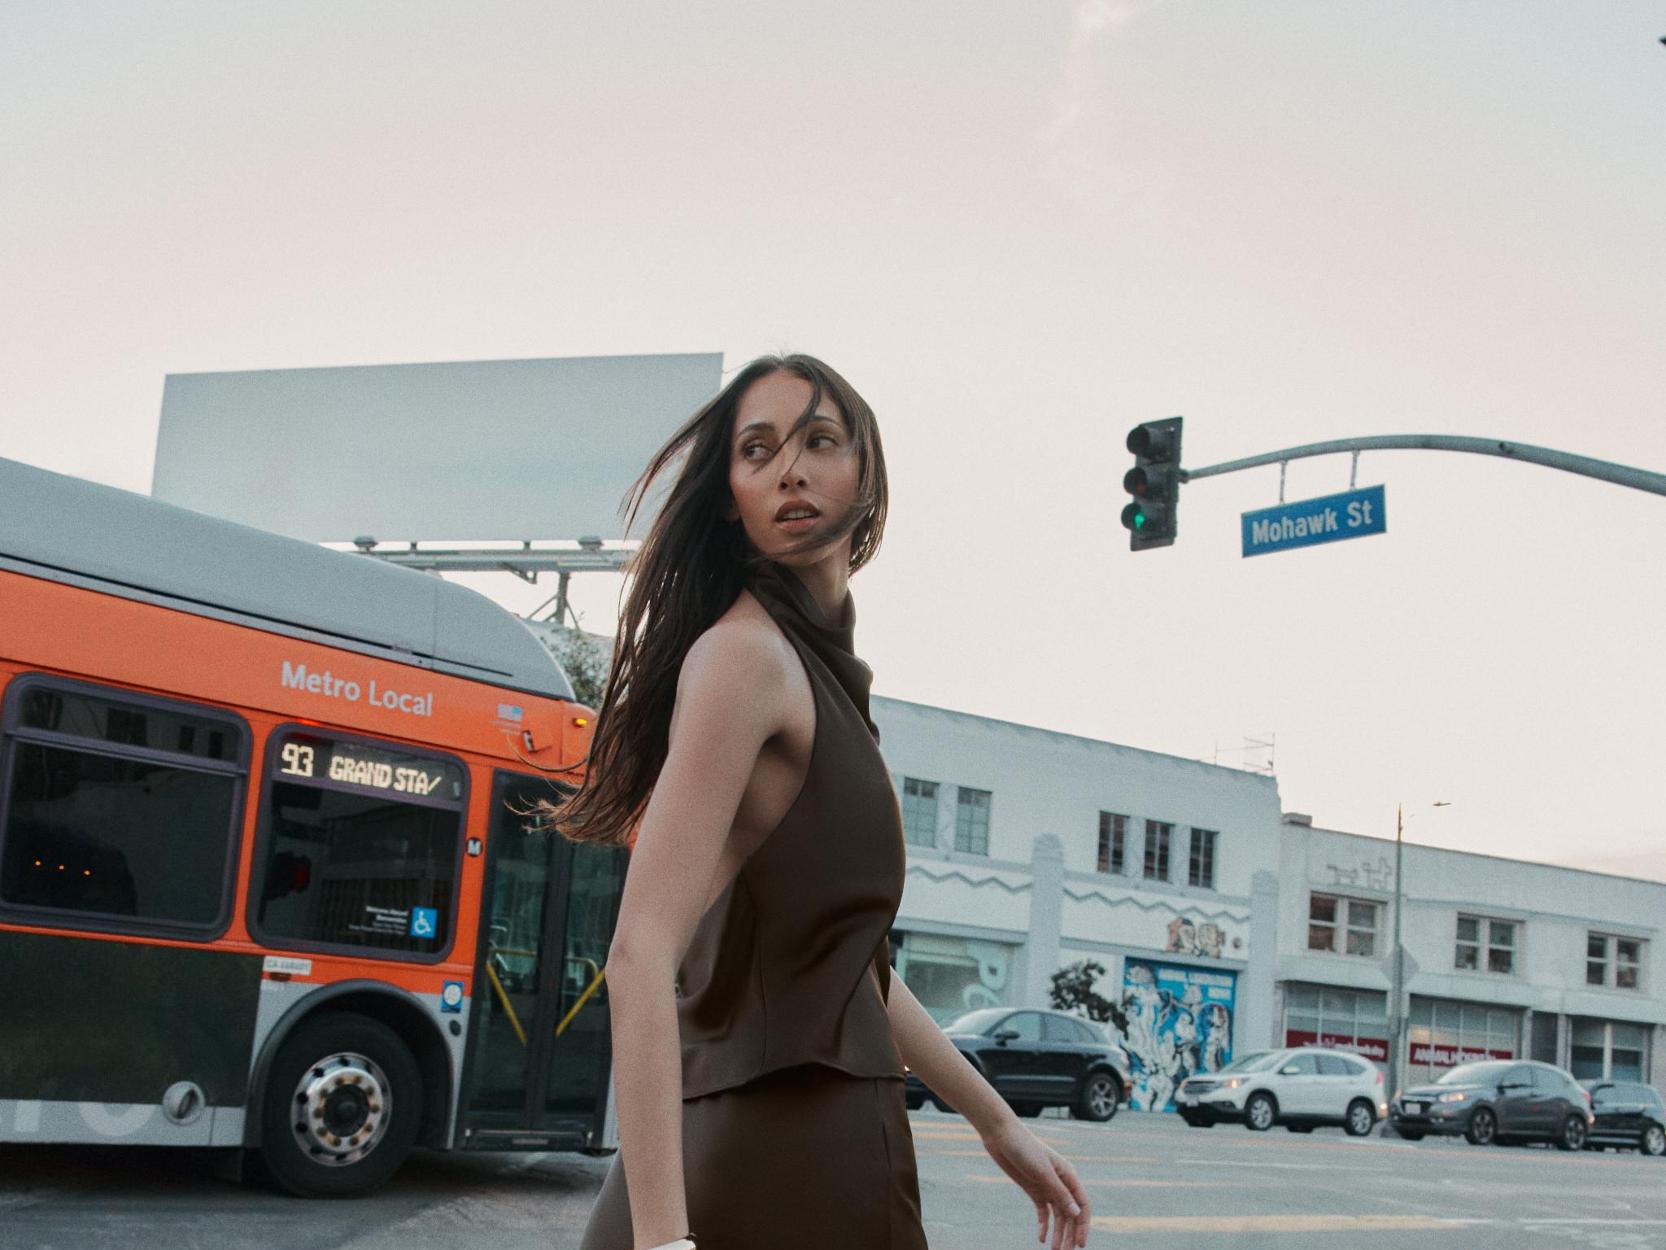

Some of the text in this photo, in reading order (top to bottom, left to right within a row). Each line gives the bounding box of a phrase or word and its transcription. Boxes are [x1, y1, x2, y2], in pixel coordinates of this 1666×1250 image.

[1252, 500, 1373, 545] Mohawk St
[281, 660, 433, 717] Metro Local
[281, 742, 314, 777] 93
[329, 755, 392, 789] GRAND
[467, 839, 482, 856] M
